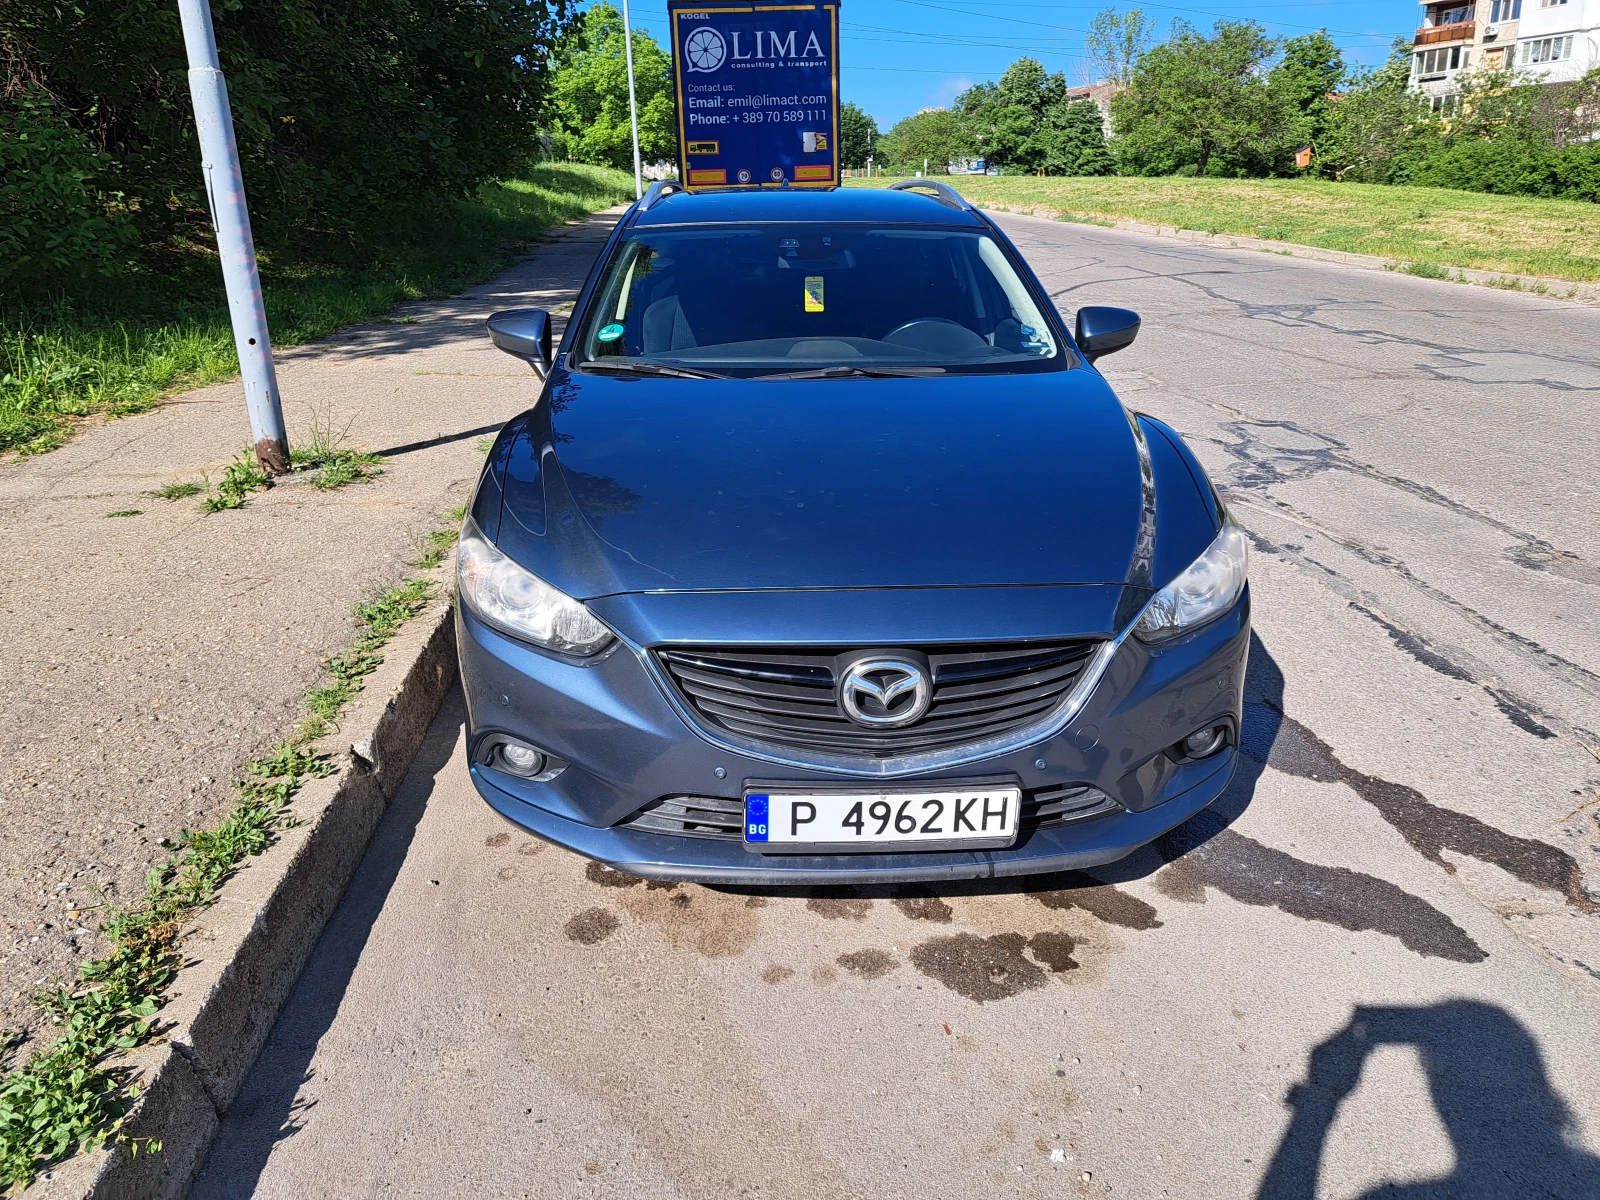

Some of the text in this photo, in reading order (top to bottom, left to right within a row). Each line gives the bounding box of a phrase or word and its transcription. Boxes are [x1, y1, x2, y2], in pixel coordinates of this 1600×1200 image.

[730, 30, 826, 59] LIMA
[687, 83, 736, 92] Contact us:
[688, 94, 827, 109] Email: emil@limact.com
[689, 112, 730, 125] Phone:
[742, 111, 764, 123] 389
[765, 110, 781, 123] 70
[783, 110, 804, 122] 589
[806, 109, 826, 121] 111
[790, 801, 817, 836] P
[749, 824, 767, 835] BG
